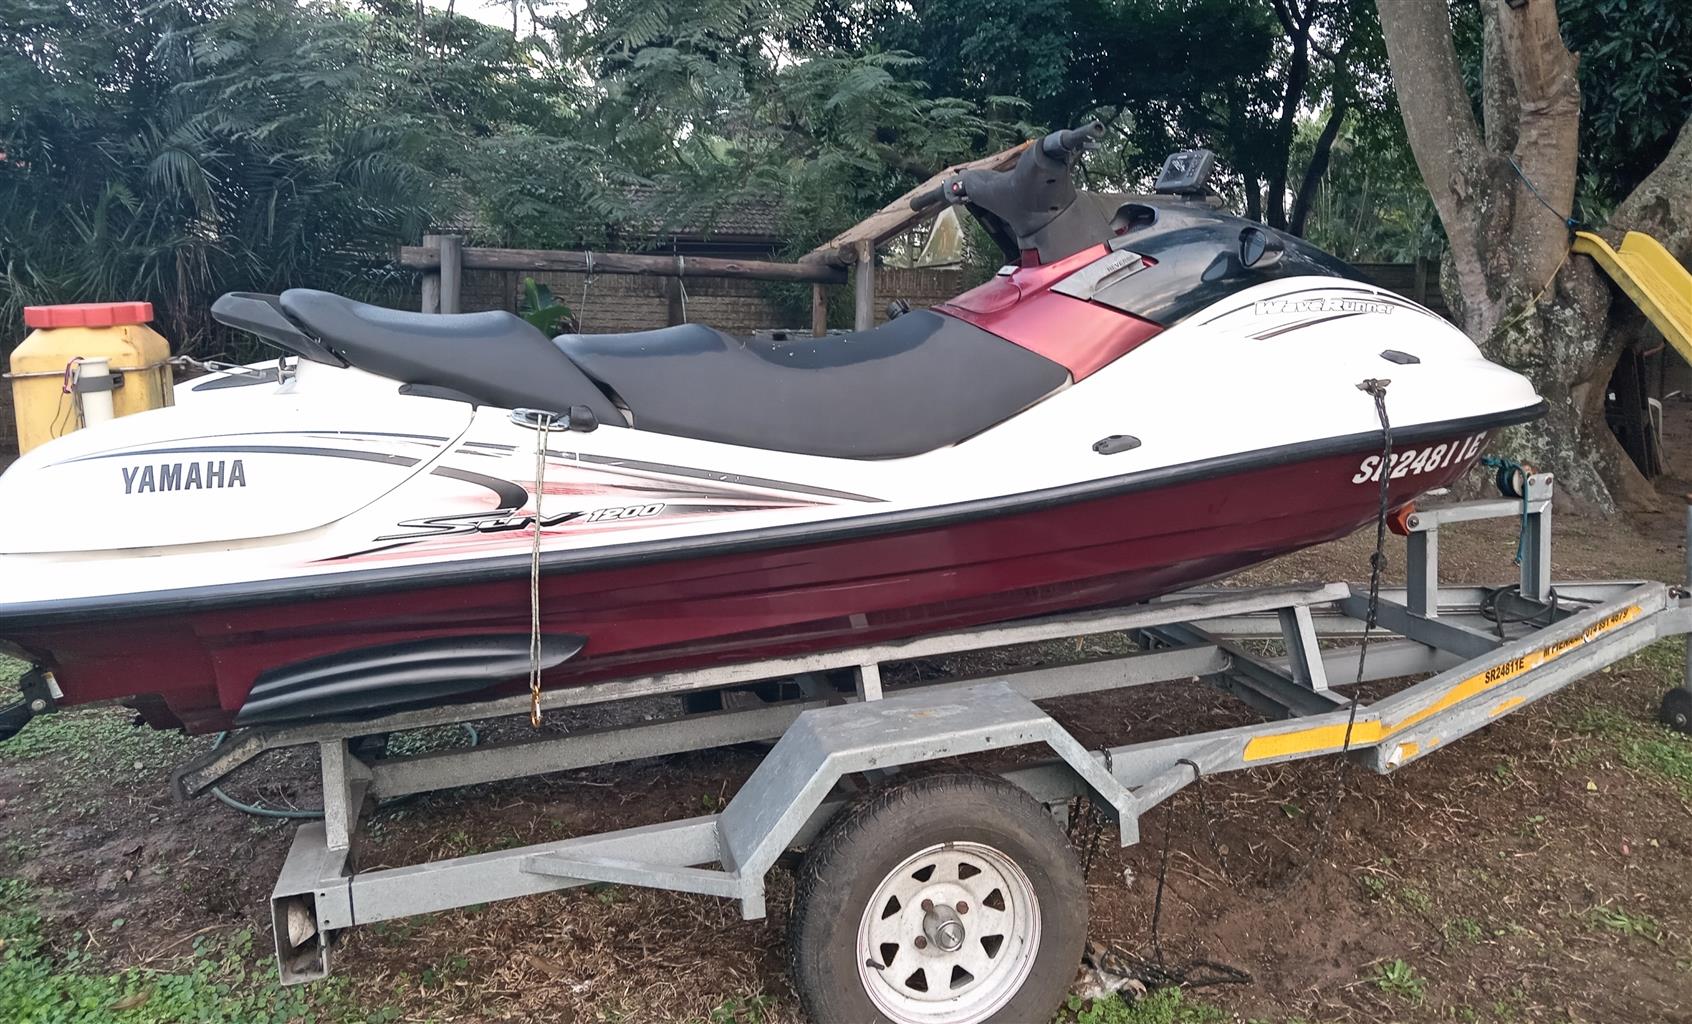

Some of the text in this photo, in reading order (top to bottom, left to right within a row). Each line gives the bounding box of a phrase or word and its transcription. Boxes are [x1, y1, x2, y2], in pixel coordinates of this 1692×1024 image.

[121, 459, 247, 494] YAMAHA
[586, 503, 666, 523] 1200
[1485, 656, 1525, 684] SR24811E
